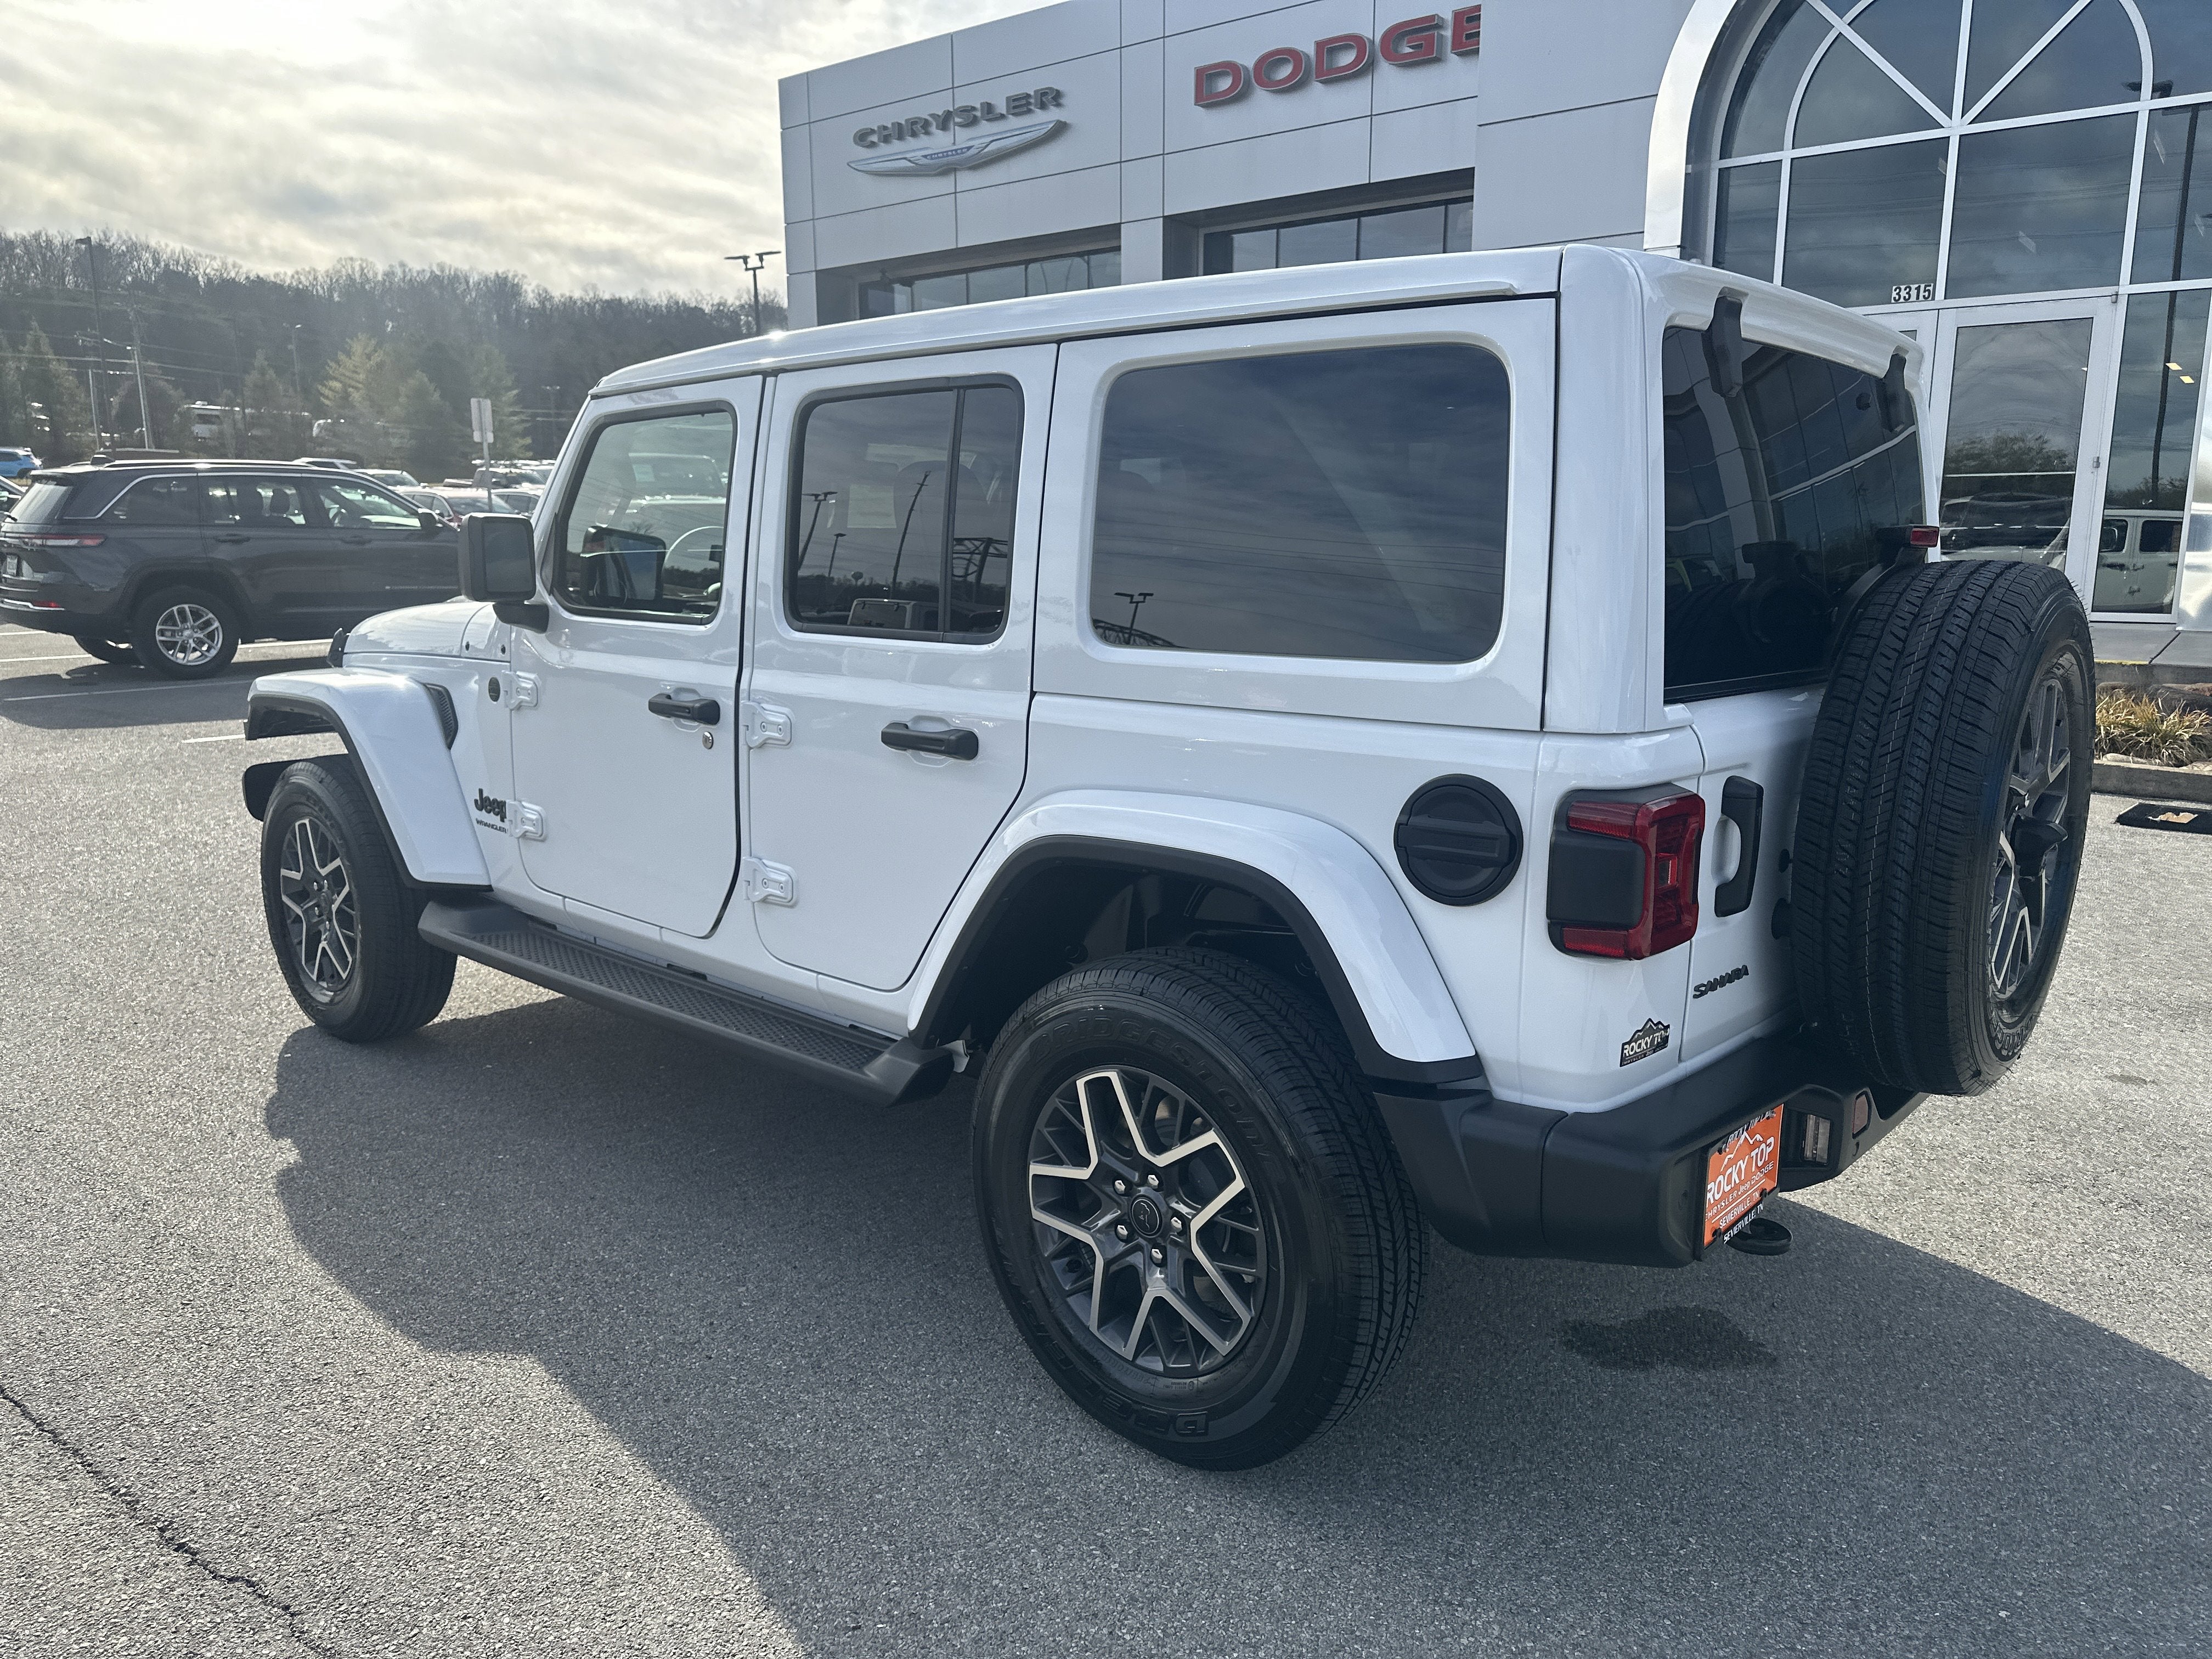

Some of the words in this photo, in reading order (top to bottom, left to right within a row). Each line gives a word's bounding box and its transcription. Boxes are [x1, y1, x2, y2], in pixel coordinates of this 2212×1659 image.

[1194, 3, 1481, 105] DODGE
[853, 86, 1062, 149] CHRYSLER
[1893, 284, 1932, 302] 3315
[474, 788, 506, 822] Jeep
[1692, 964, 1749, 998] SAHARA
[1623, 1035, 1653, 1057] ROCKY
[1706, 1154, 1748, 1208] ROCKY
[1751, 1136, 1775, 1173] TOP
[1738, 1181, 1750, 1195] Jeep
[1751, 1160, 1774, 1184] DODGE
[1753, 1189, 1759, 1202] TN
[1757, 1201, 1764, 1214] TN
